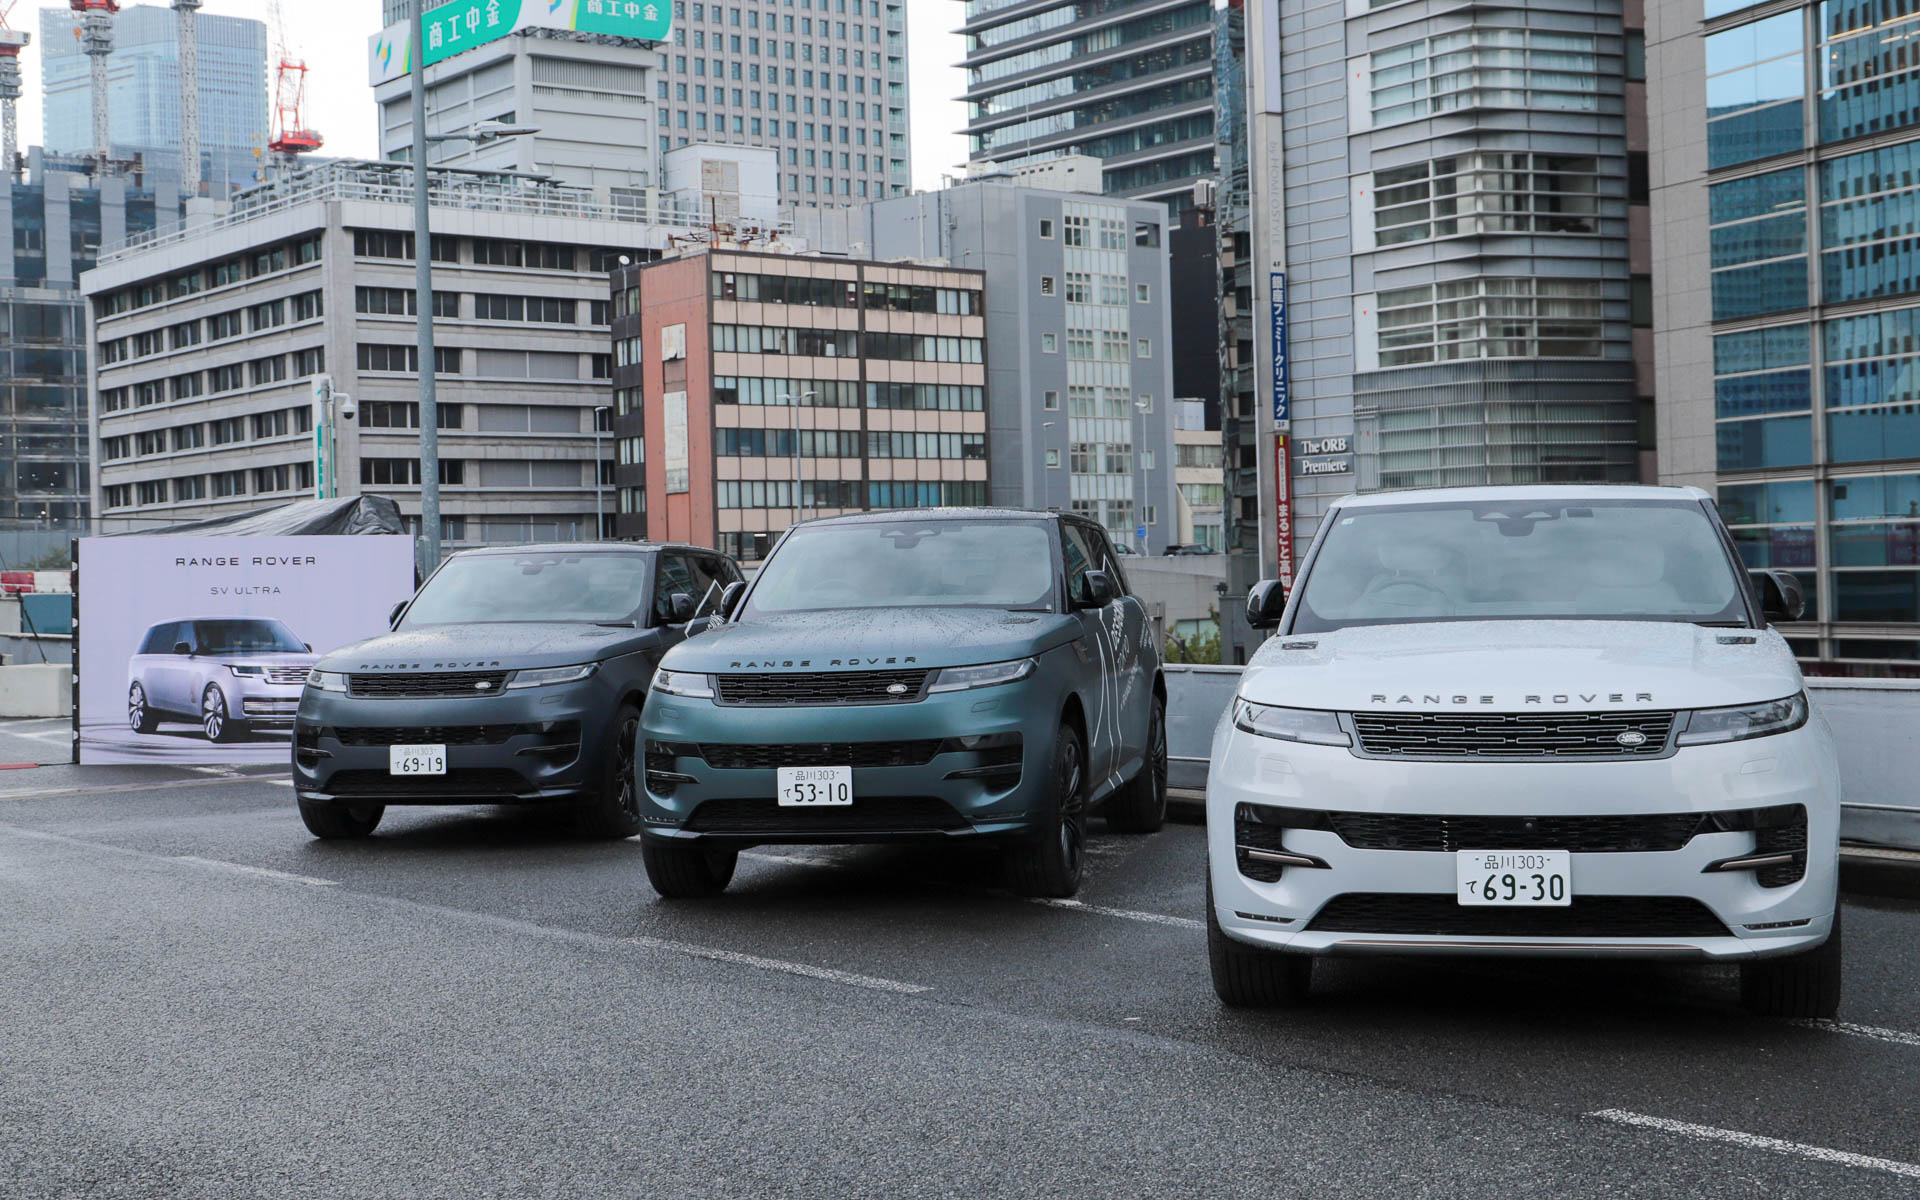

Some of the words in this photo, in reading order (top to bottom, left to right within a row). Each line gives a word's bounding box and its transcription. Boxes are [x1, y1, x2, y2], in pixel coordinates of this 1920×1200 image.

[588, 0, 659, 21] 商工中金
[429, 0, 500, 50] 商工中金
[1301, 440, 1320, 455] The
[1321, 437, 1346, 453] ORB
[1302, 458, 1347, 474] Premiere
[175, 557, 240, 566] RANGE
[252, 556, 316, 566] ROVER
[210, 586, 229, 595] SV
[234, 586, 281, 595] ULTRA
[730, 659, 811, 668] RANGE
[830, 656, 917, 666] ROVER
[1371, 694, 1494, 704] RANGE
[1525, 693, 1653, 704] ROVER
[403, 757, 443, 772] 69-19
[794, 782, 848, 803] 53-10
[1483, 873, 1564, 901] 69-30
